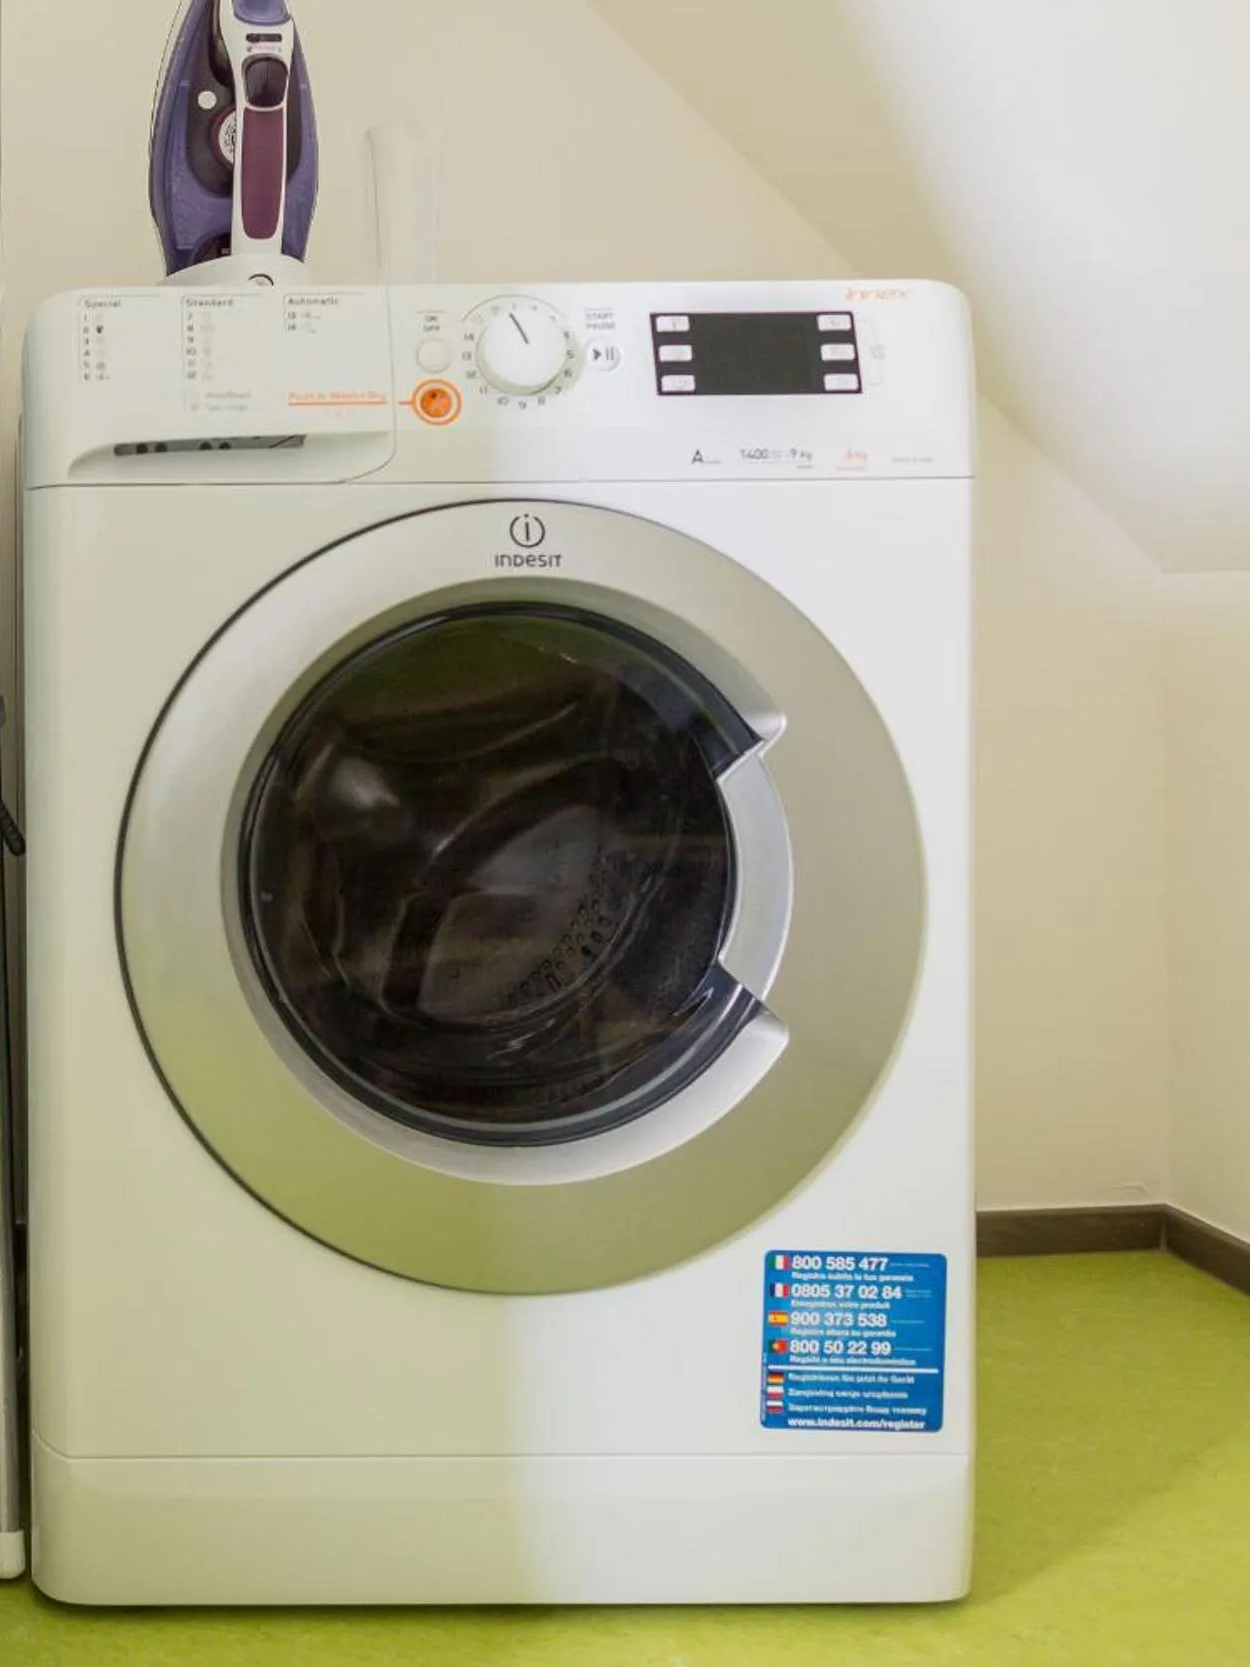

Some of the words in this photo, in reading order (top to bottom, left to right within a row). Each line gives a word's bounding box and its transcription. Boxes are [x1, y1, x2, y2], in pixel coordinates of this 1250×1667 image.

[83, 299, 121, 309] Special
[791, 1255, 822, 1270] 800
[825, 1256, 855, 1271] 585
[858, 1257, 889, 1271] 477
[791, 1284, 830, 1298] 0805
[835, 1285, 854, 1299] 37
[858, 1285, 878, 1300] 02
[882, 1286, 902, 1300] 84
[790, 1311, 820, 1325] 900
[824, 1312, 854, 1326] 373
[857, 1313, 887, 1328] 538
[790, 1339, 819, 1353] 800
[824, 1340, 844, 1354] 50
[847, 1341, 868, 1355] 22
[871, 1341, 892, 1355] 99
